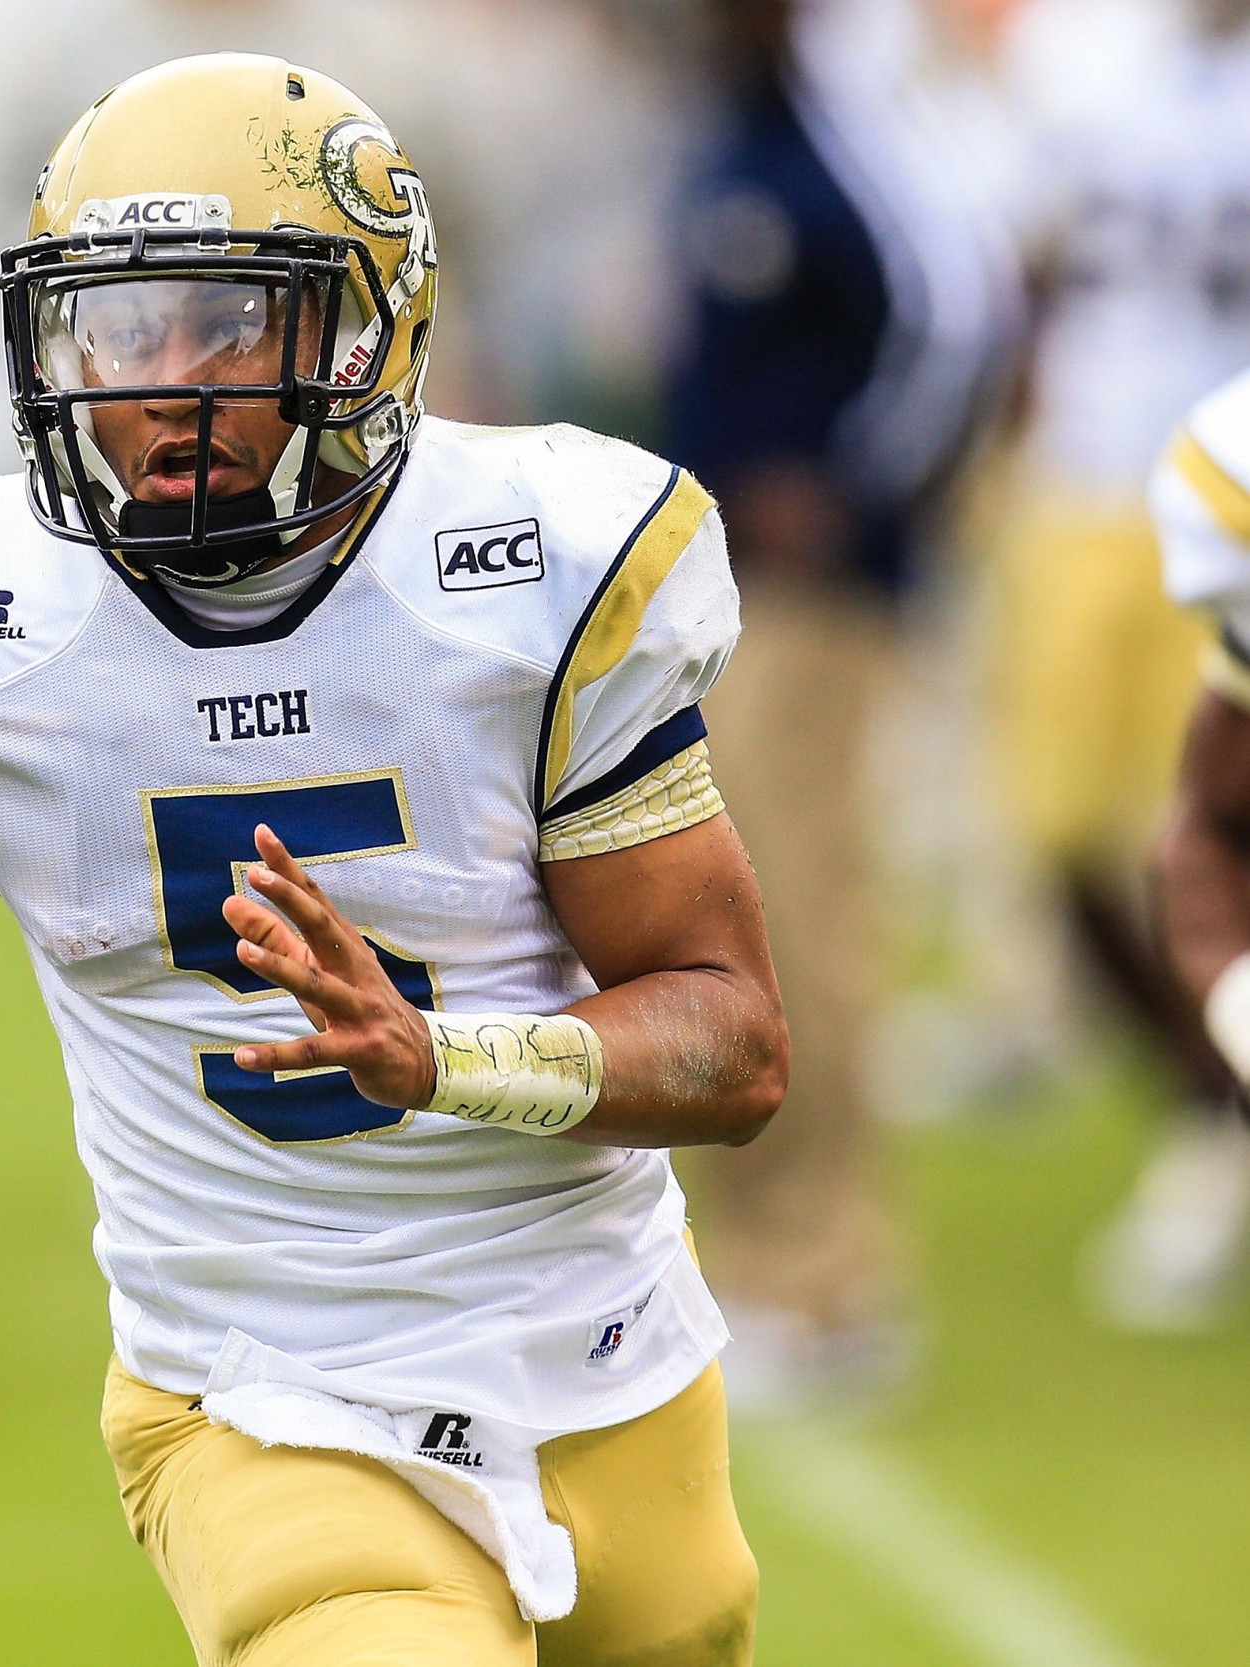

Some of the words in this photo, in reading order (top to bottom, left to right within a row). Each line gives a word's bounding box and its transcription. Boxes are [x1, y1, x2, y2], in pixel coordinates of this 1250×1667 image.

[117, 200, 187, 226] ACC
[443, 531, 537, 576] ACC
[196, 689, 311, 742] TECH
[138, 766, 418, 1148] 5
